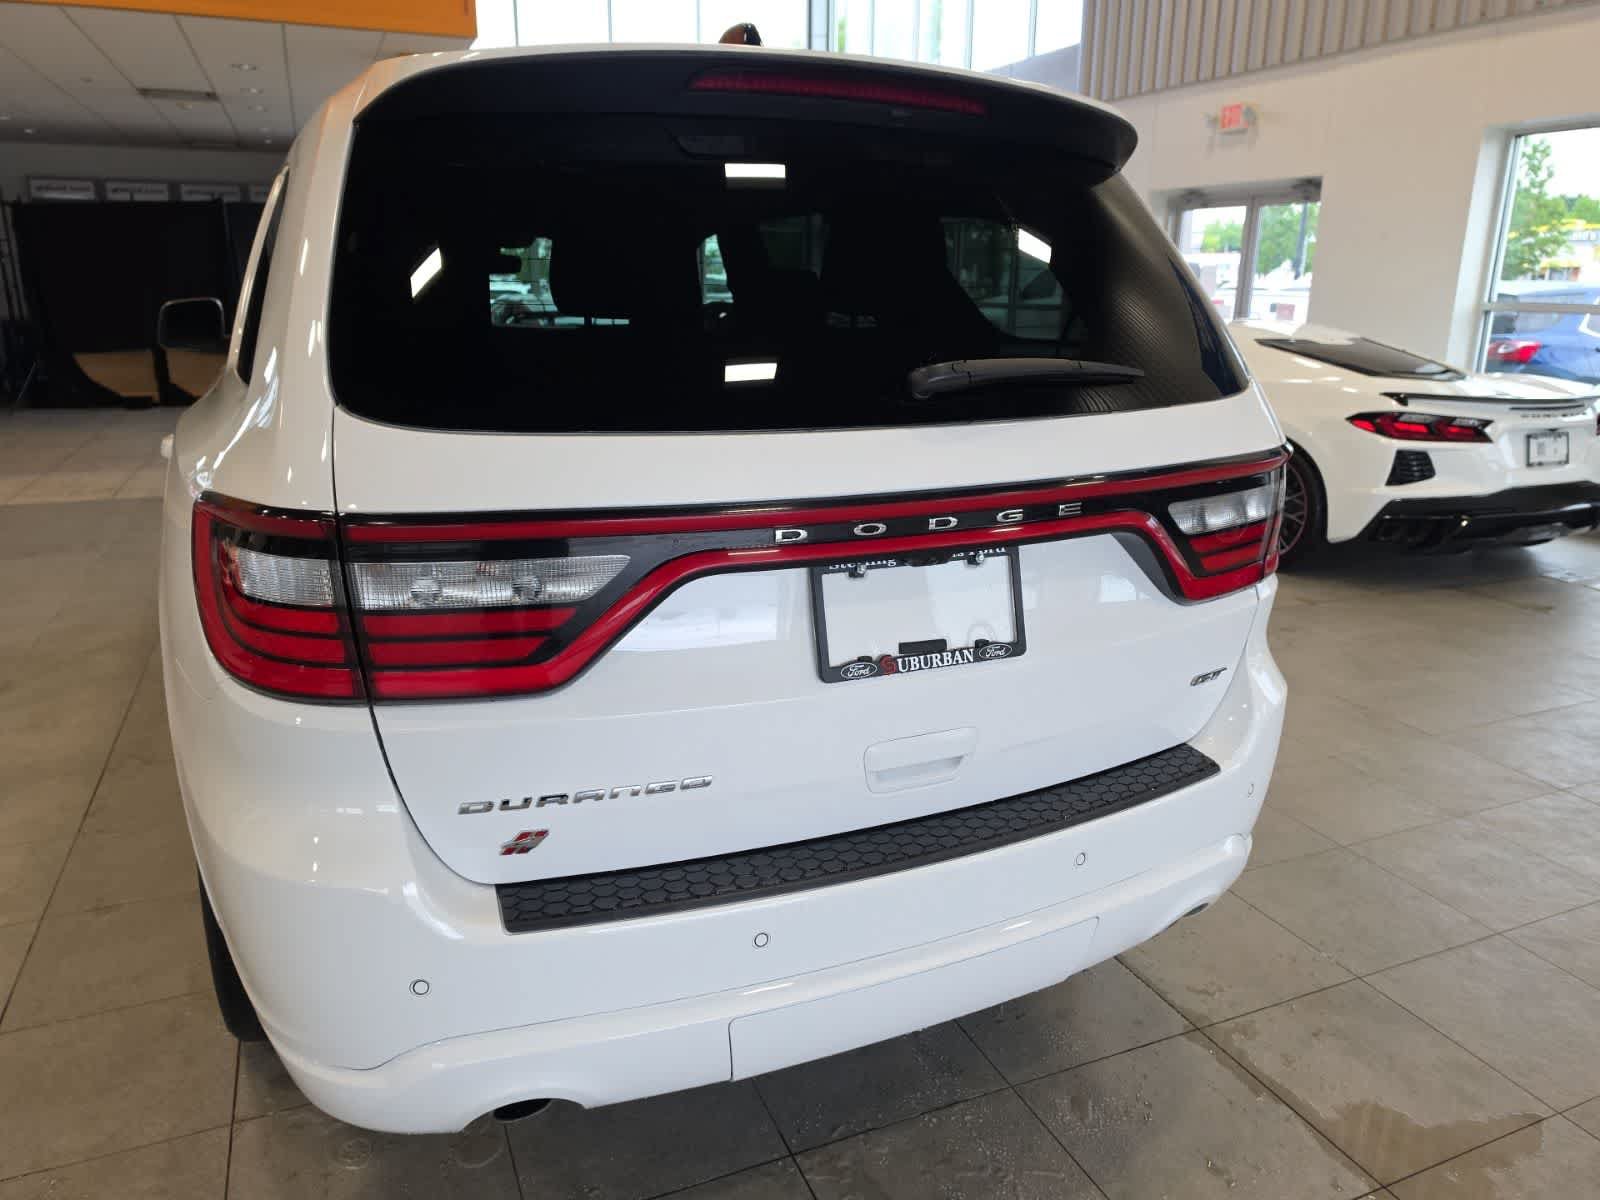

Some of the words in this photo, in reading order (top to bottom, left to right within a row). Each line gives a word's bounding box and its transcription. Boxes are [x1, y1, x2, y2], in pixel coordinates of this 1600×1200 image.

[774, 502, 1083, 544] DODGE
[846, 662, 873, 678] Ford
[880, 648, 974, 675] SUBURBAN
[984, 645, 1007, 658] Ford
[457, 774, 713, 815] DURANGO
